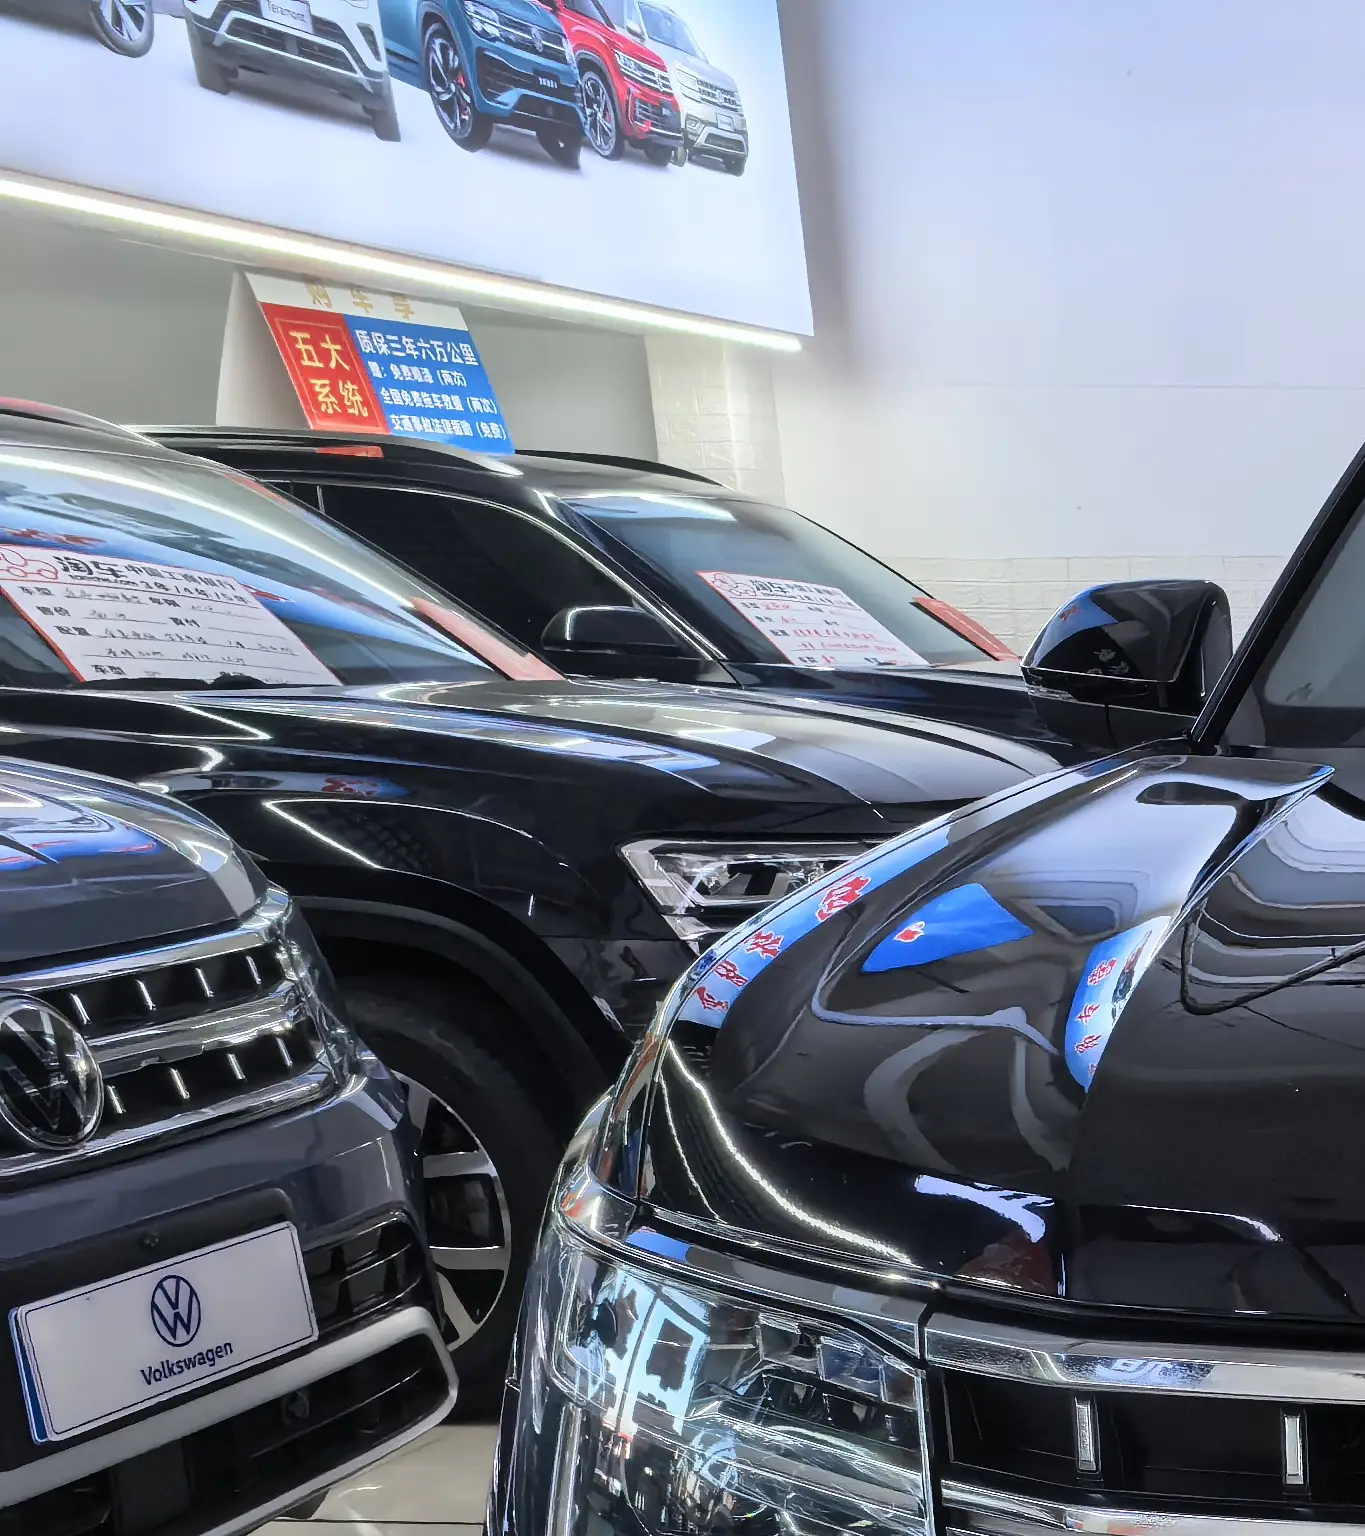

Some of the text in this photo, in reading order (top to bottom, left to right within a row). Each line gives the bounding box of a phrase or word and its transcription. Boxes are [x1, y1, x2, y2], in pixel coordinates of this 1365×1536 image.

[288, 330, 351, 372] 五大
[355, 329, 479, 366] 质保三年六万公里
[308, 378, 369, 418] 系统
[139, 1338, 234, 1387] Volkswagen
